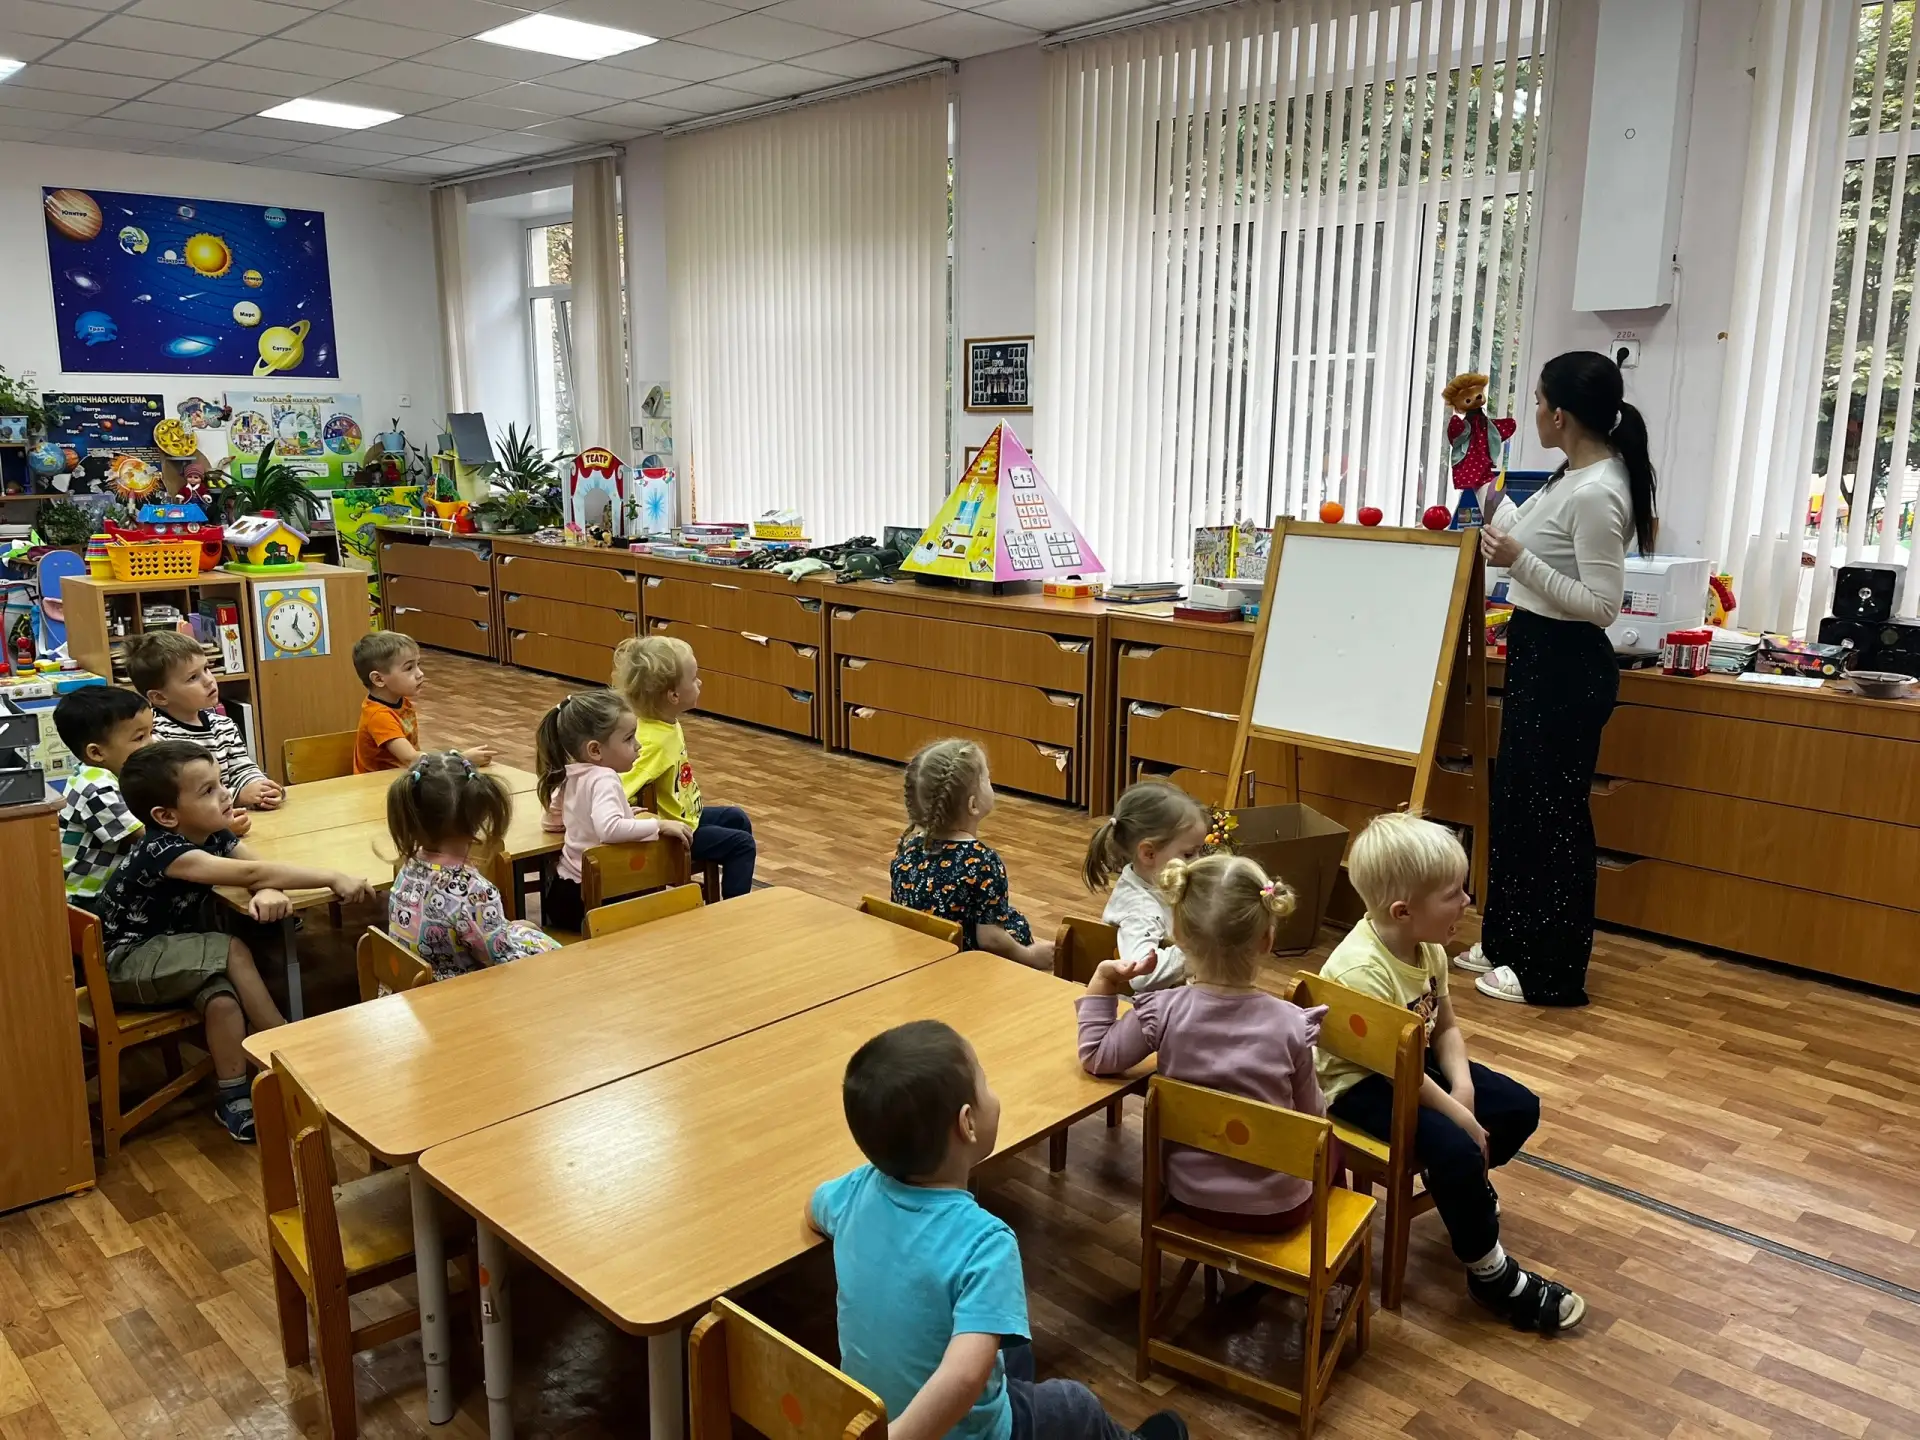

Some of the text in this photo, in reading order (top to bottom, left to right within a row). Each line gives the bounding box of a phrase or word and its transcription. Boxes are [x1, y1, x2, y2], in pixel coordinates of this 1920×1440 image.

[58, 395, 147, 404] СОЛНЕЧНАЯ СИСТЕМА
[585, 454, 609, 463] ТЕАТР
